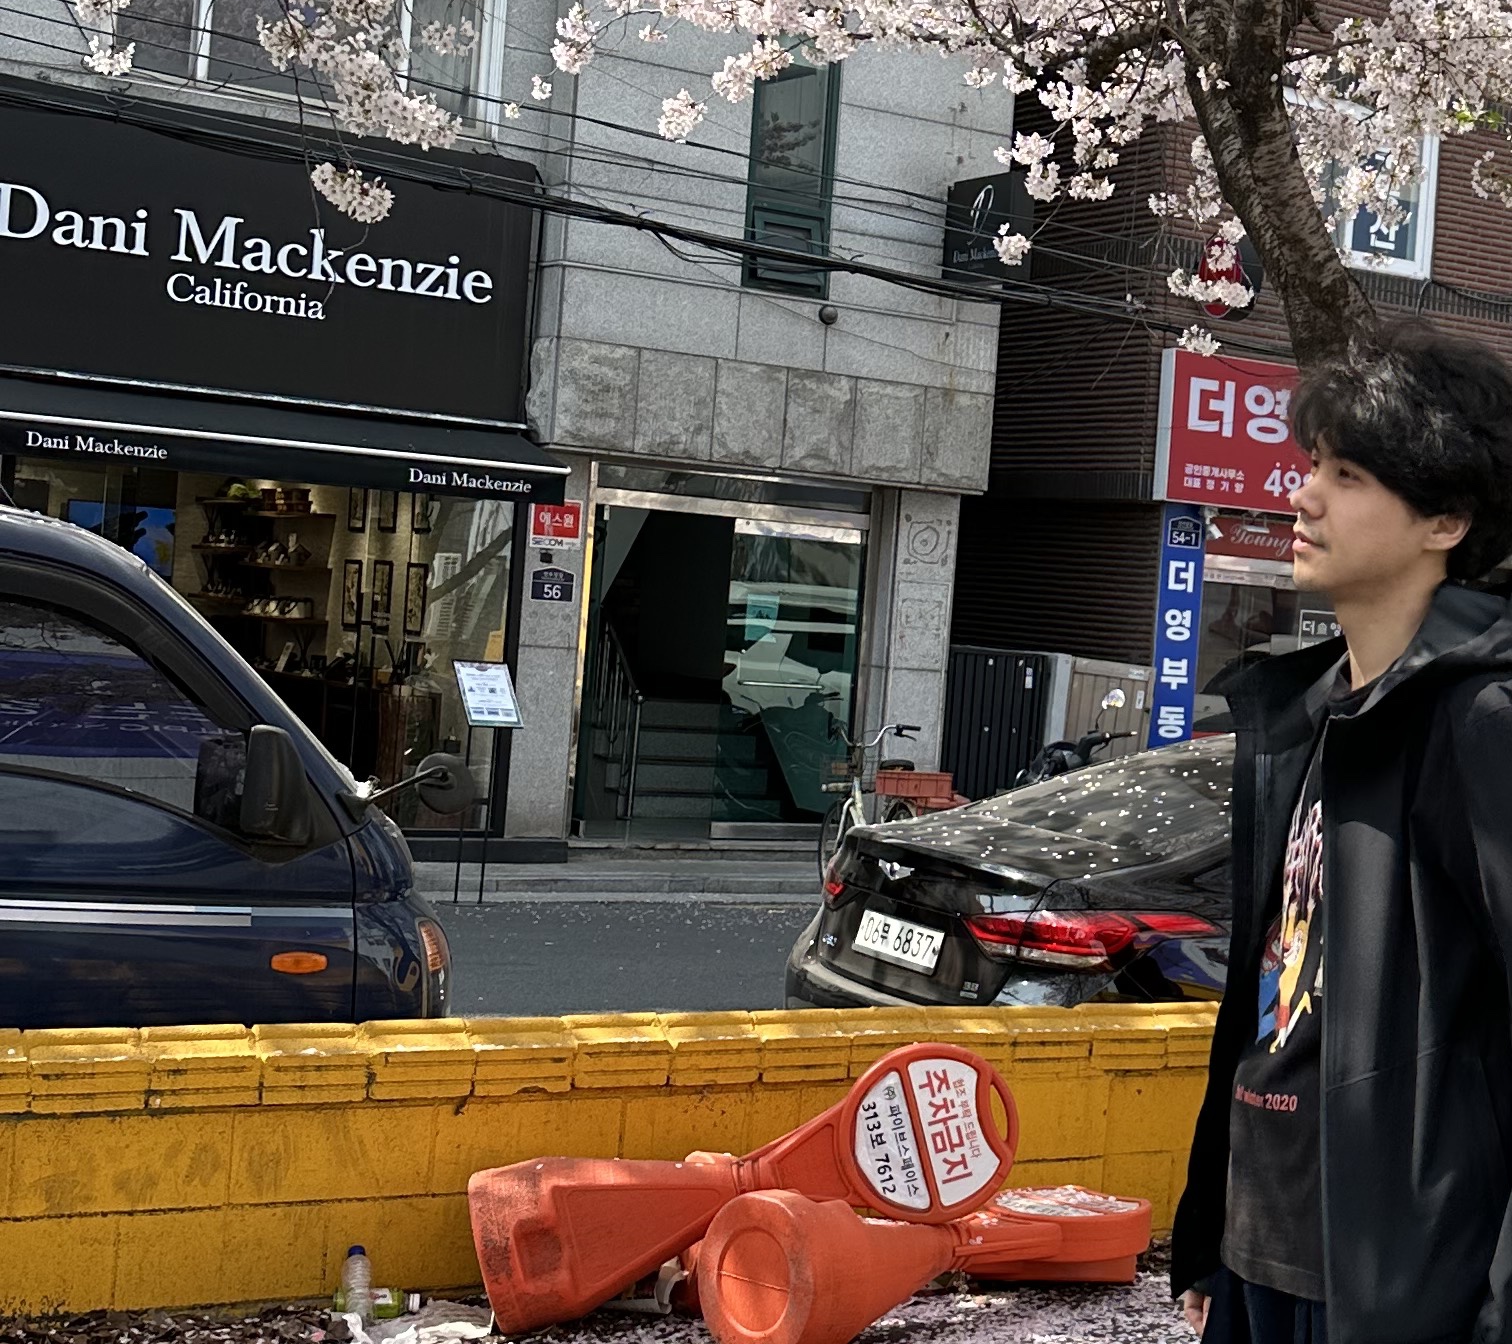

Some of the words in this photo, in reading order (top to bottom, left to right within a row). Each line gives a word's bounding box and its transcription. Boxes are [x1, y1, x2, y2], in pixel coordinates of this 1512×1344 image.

[0, 182, 150, 256] Dani
[170, 208, 494, 304] Mackenzie
[166, 273, 326, 320] California
[1187, 376, 1292, 444] 더영
[26, 430, 70, 450] Dani
[74, 435, 168, 460] Mackenzie
[408, 467, 447, 486] Dani
[451, 472, 532, 494] Mackenzie
[1172, 531, 1196, 546] 54-1
[543, 584, 562, 598] 56
[893, 925, 934, 960] 6837
[1265, 1092, 1298, 1113] 2020
[918, 1068, 973, 1185] 주차금지
[862, 1101, 887, 1150] 313보
[875, 1153, 897, 1195] 7612
[887, 1104, 921, 1197] 파이브스페이스
